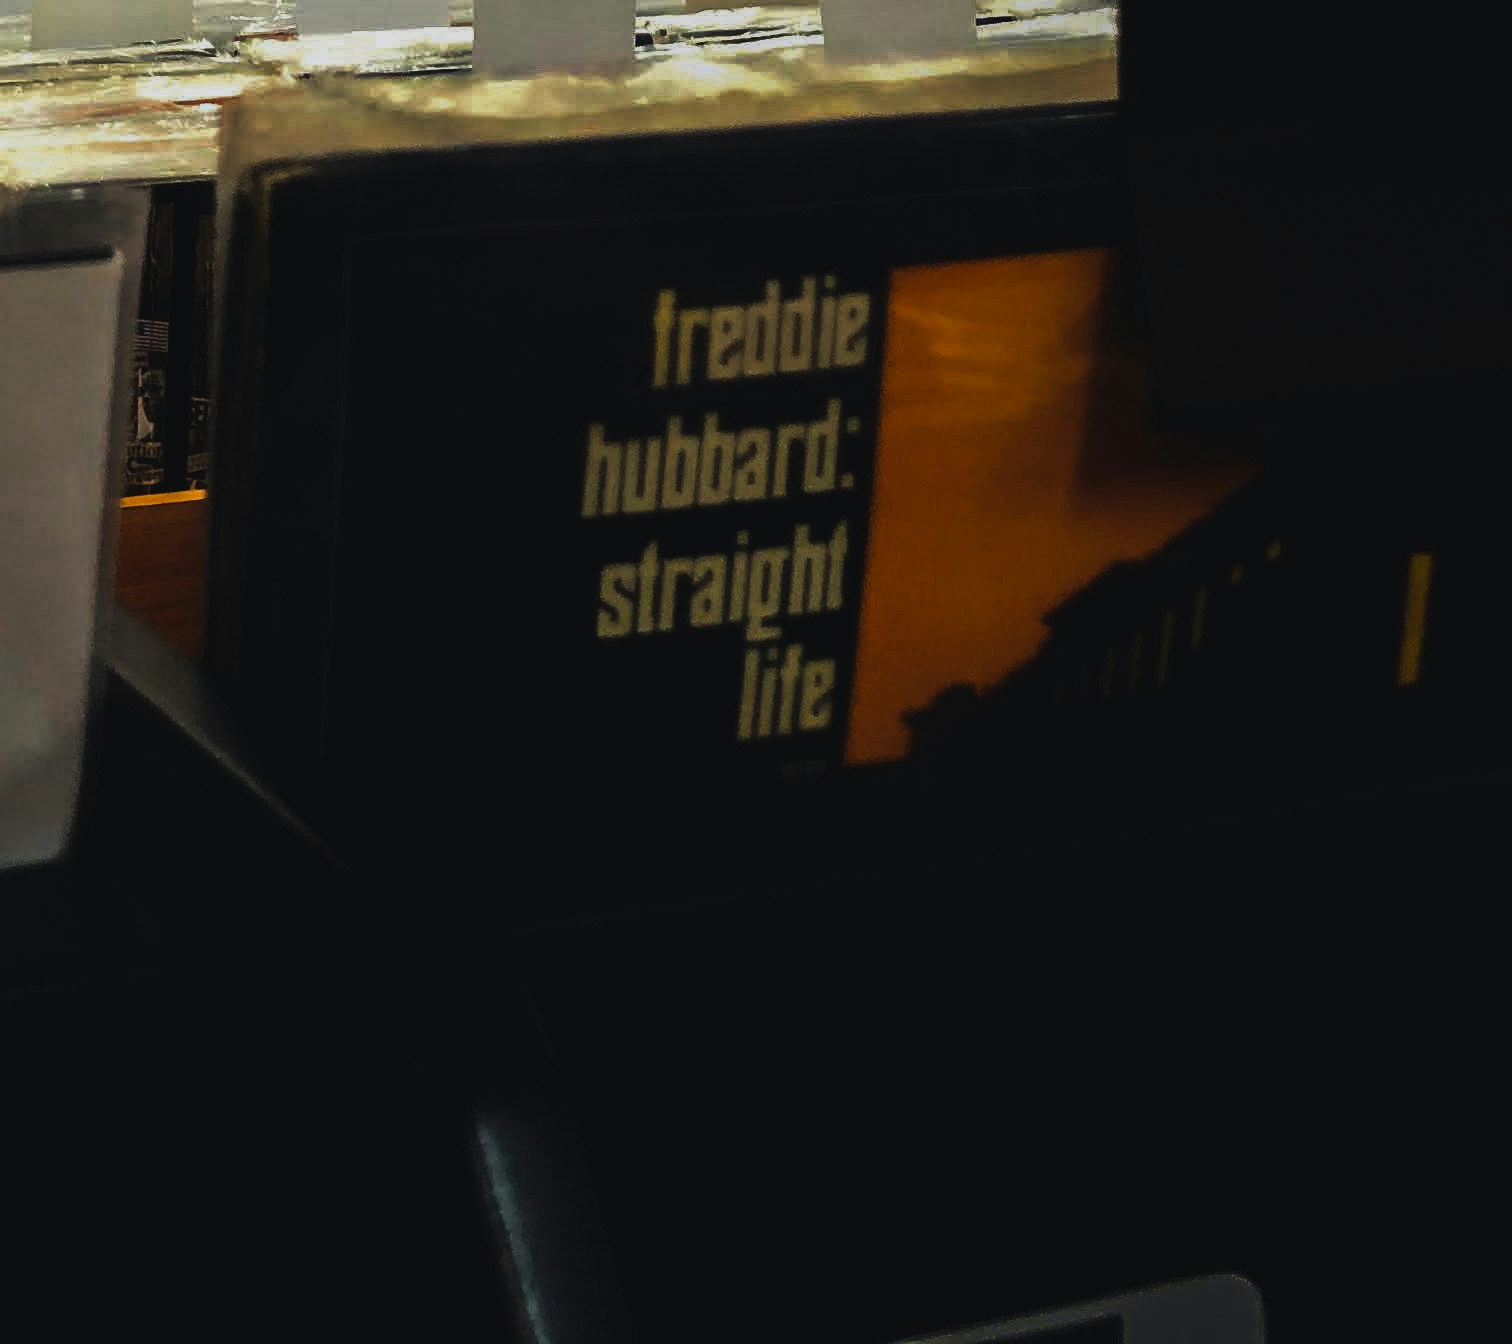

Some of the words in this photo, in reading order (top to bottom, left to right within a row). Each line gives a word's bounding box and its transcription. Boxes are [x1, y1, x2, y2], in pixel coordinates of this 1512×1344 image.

[652, 274, 873, 390] freddie
[580, 398, 860, 519] hubbard:
[596, 520, 850, 641] straight
[735, 642, 837, 741] life
